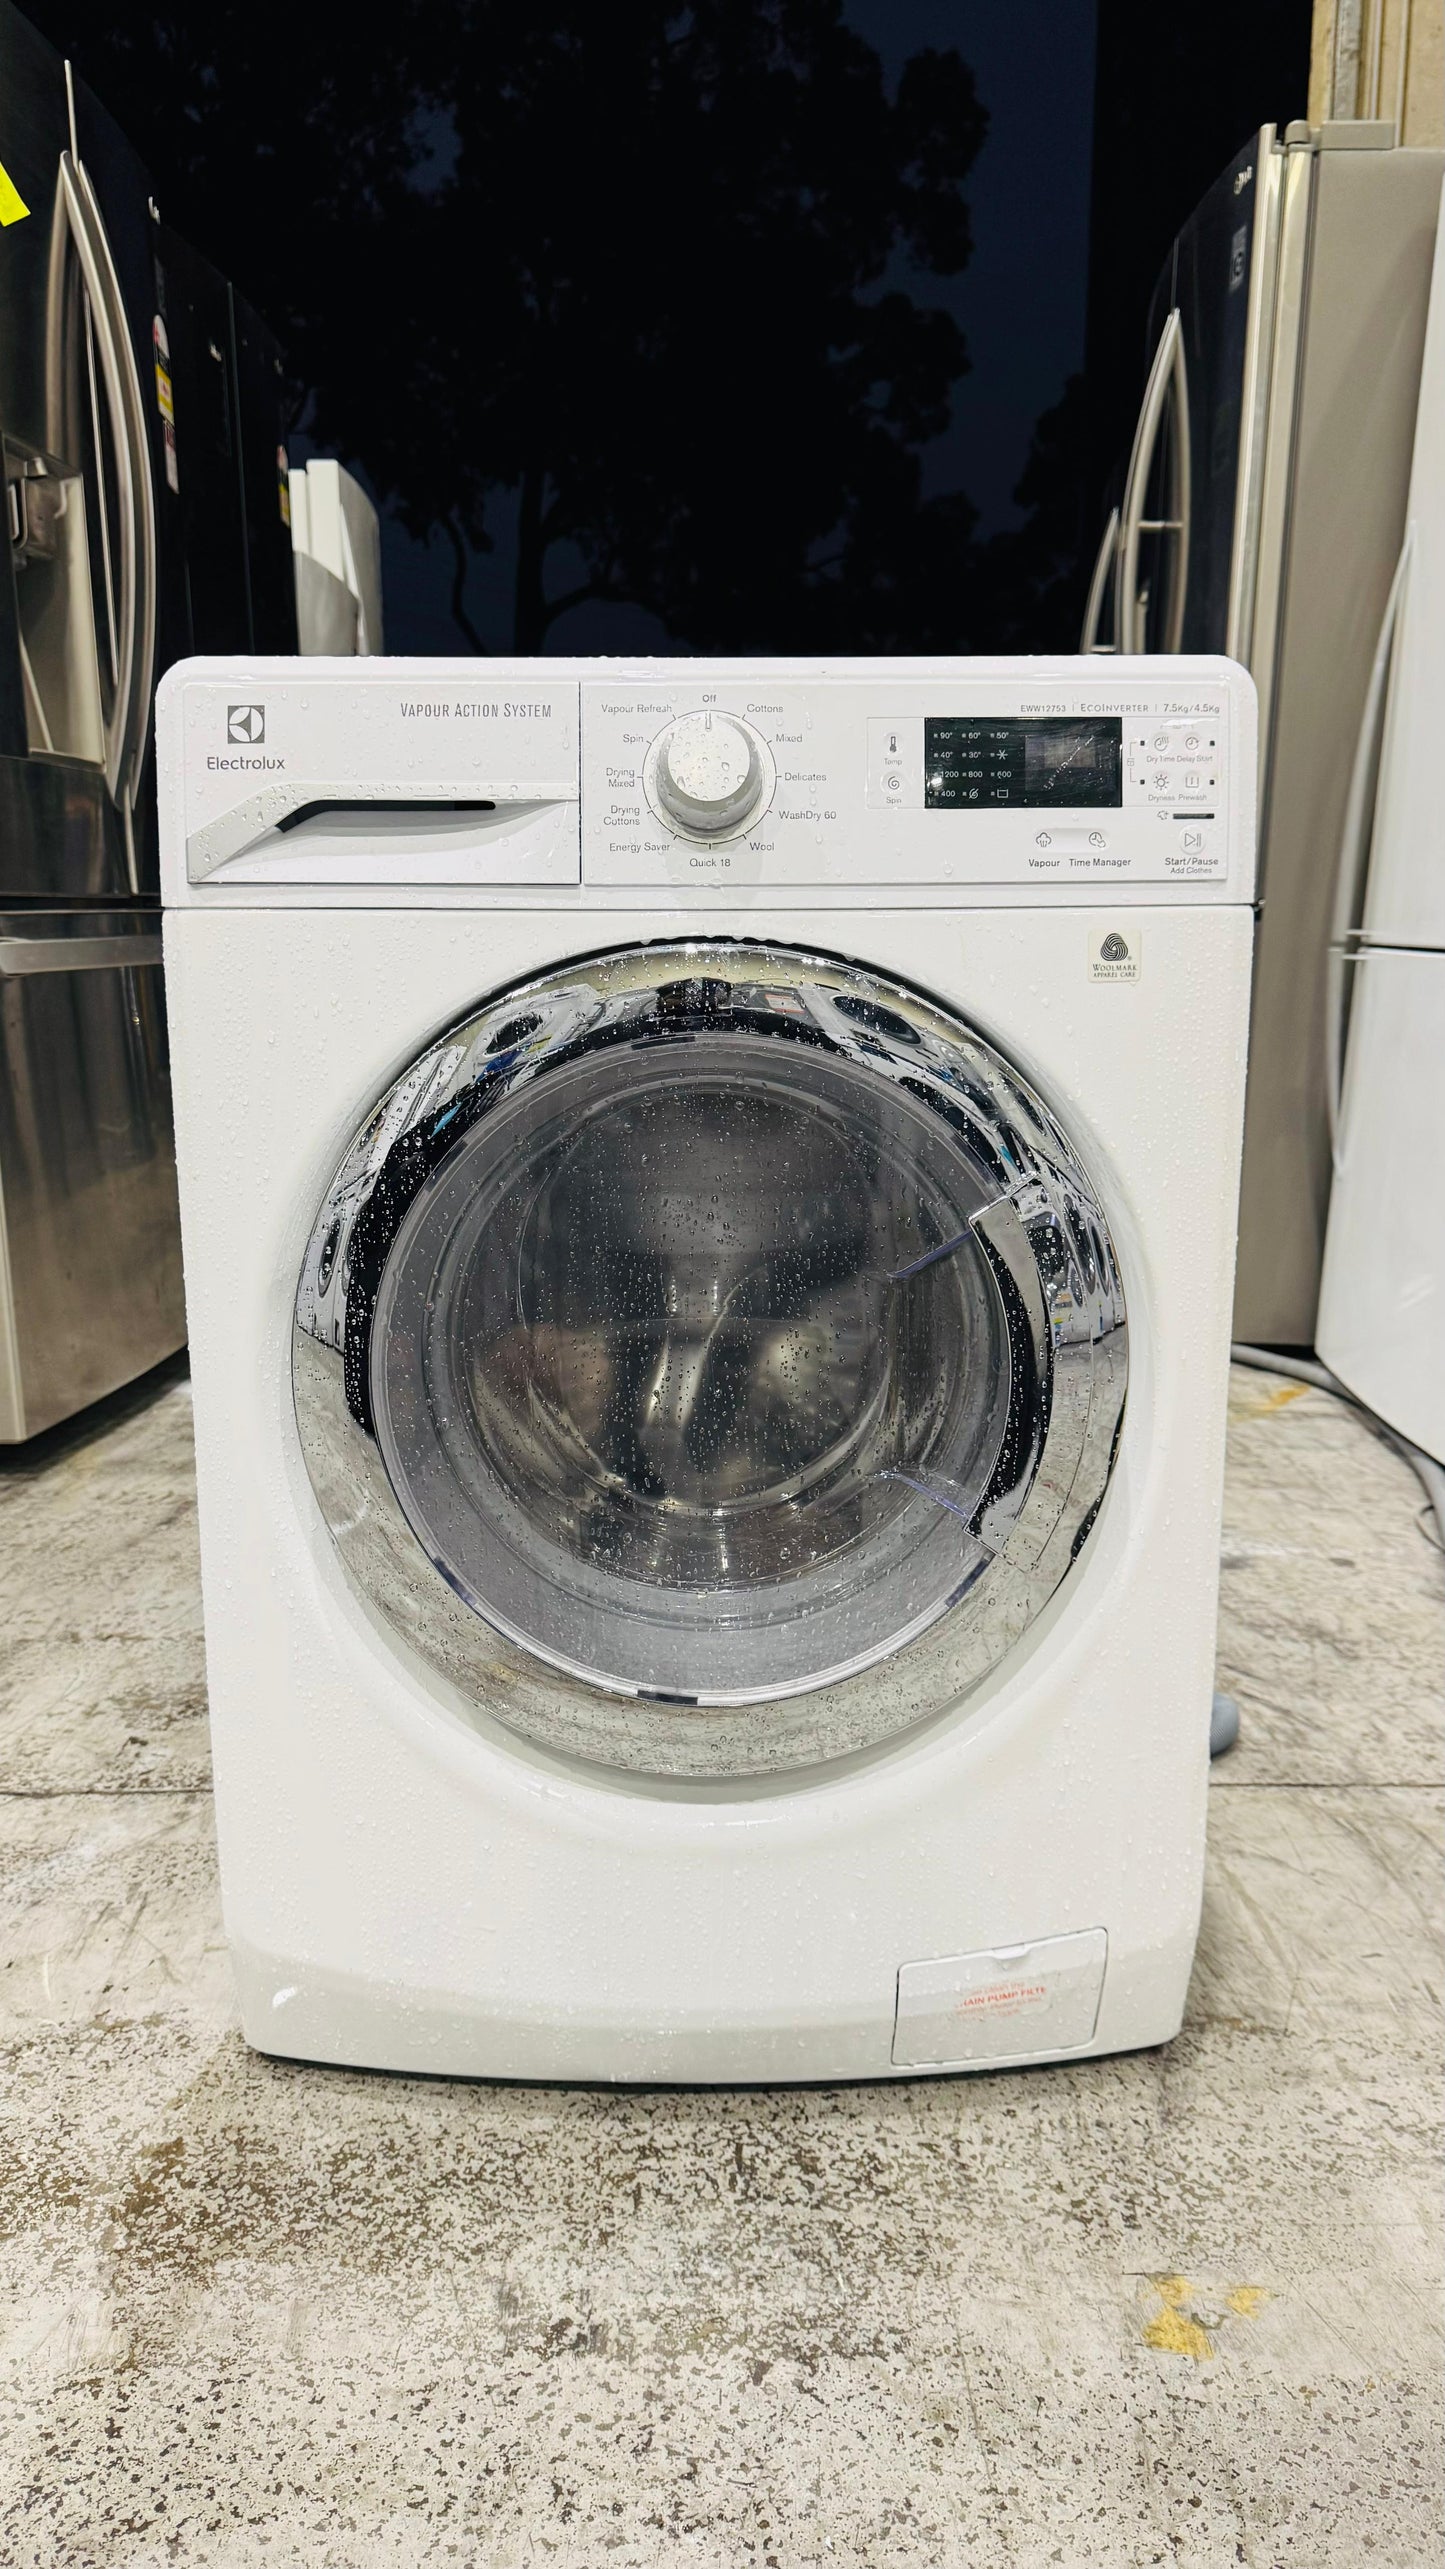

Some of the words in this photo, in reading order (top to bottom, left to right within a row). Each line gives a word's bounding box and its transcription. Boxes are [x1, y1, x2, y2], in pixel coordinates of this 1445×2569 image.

[702, 694, 717, 703] Off
[400, 703, 450, 718] VAPOUR
[455, 703, 498, 718] ACTION
[503, 703, 552, 718] SYSTEM
[602, 704, 633, 715] Vapour
[637, 704, 672, 713] Refresh
[747, 704, 783, 713] Cottons
[623, 734, 644, 744] Spin
[776, 734, 803, 743] Mixed
[207, 756, 285, 770] Electrolux
[1147, 756, 1158, 764] Dry
[606, 768, 635, 779] Drying
[785, 772, 827, 781] Delicates
[608, 779, 635, 788] Mixed
[886, 797, 902, 805] Spin
[611, 806, 640, 817] Drying
[779, 811, 821, 821] WashDry
[824, 811, 837, 820] 60
[604, 816, 640, 826] Cottons
[610, 843, 641, 853] Energy
[644, 843, 670, 851] Saver
[750, 842, 775, 851] Wool
[690, 858, 717, 868] Quick
[720, 858, 731, 867] 18
[1029, 859, 1060, 868] Vapour
[1093, 859, 1131, 868] Manager
[1165, 858, 1219, 866] Start/Pause
